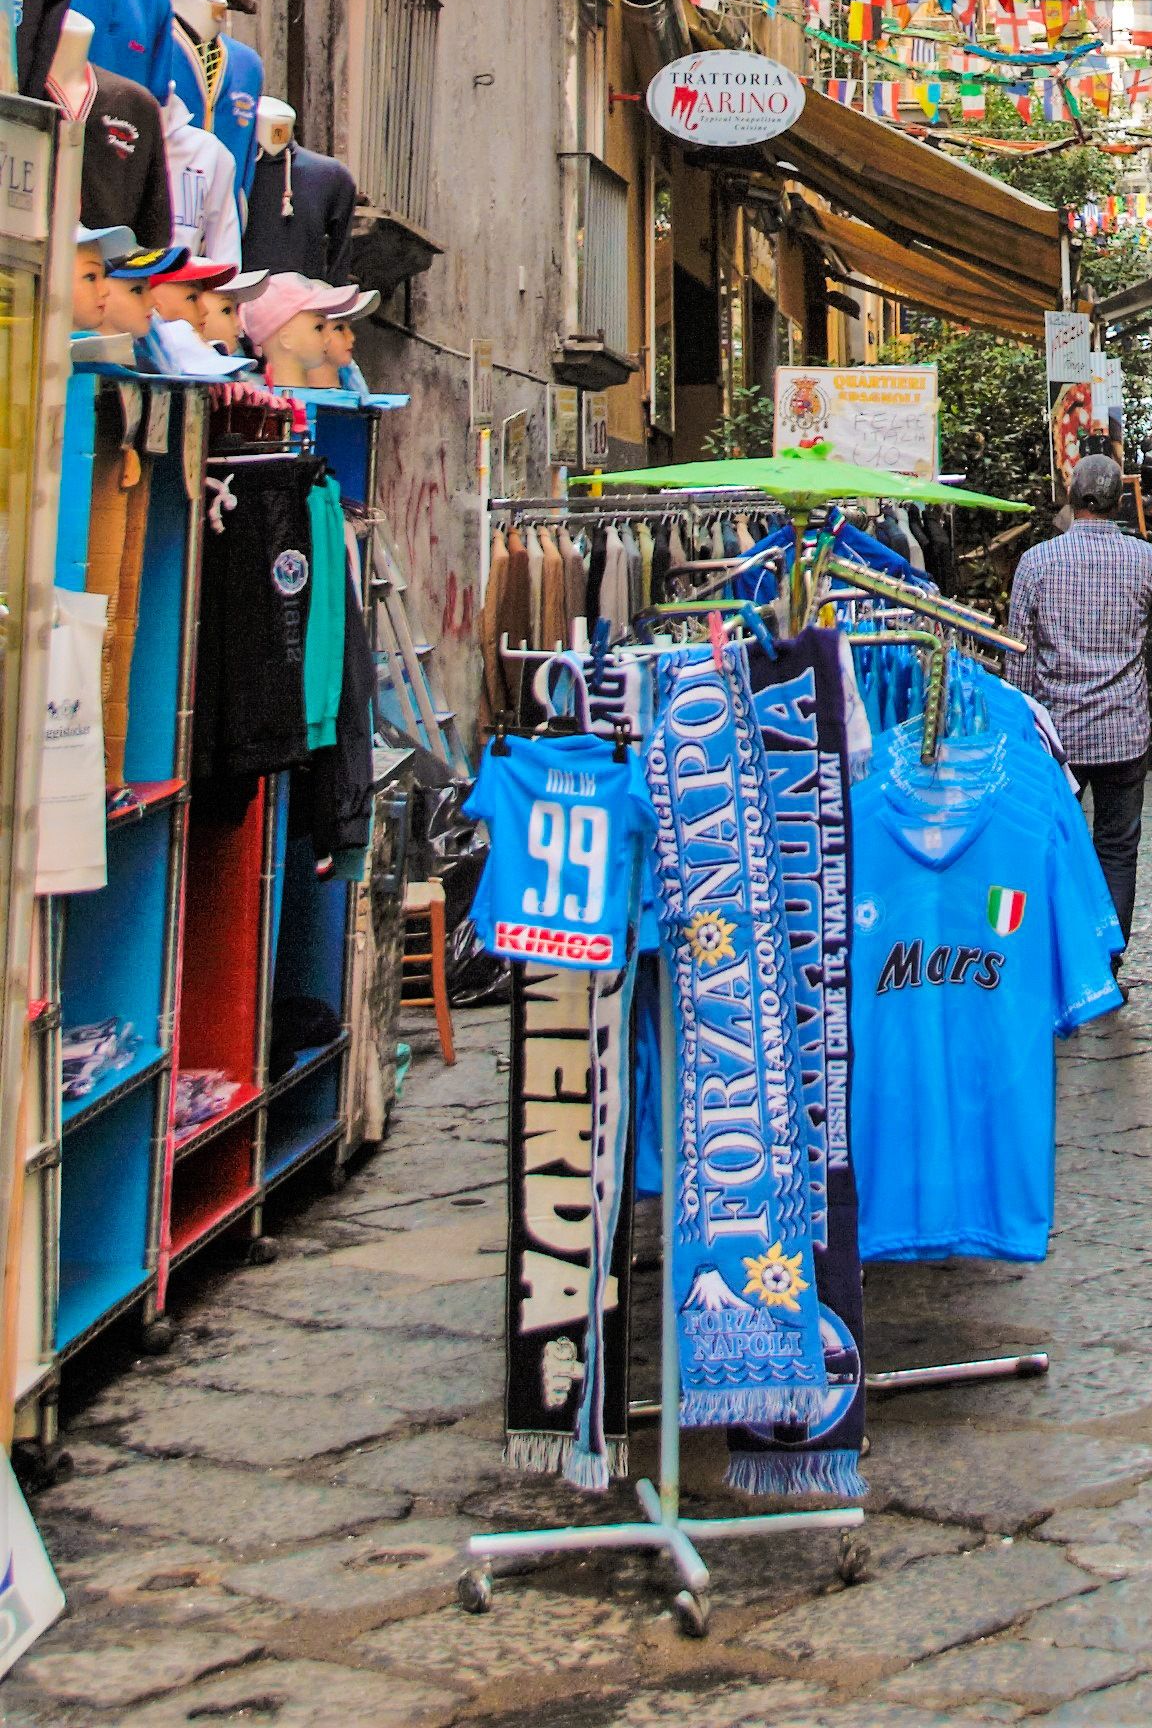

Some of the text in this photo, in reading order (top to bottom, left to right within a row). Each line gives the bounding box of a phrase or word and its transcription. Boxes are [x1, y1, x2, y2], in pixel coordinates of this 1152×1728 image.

[670, 72, 783, 86] TRATTORIA
[671, 86, 789, 130] MARINO
[833, 375, 926, 390] QUARTIERI
[522, 799, 609, 924] 99
[743, 806, 772, 915] TUTTO
[821, 824, 846, 847] TI
[820, 854, 848, 940] NAPOLI
[752, 919, 780, 985] CON
[822, 946, 849, 983] TE,
[876, 938, 1006, 995] Mars
[676, 941, 697, 1063] GLORIA
[823, 987, 849, 1055] COME
[759, 988, 791, 1134] AMIAMO
[695, 951, 771, 1248] FORZA
[824, 1059, 850, 1169] NESSUNO
[770, 1144, 794, 1178] TI
[682, 1307, 776, 1334] FORZA
[692, 1331, 803, 1361] NAPOLI
